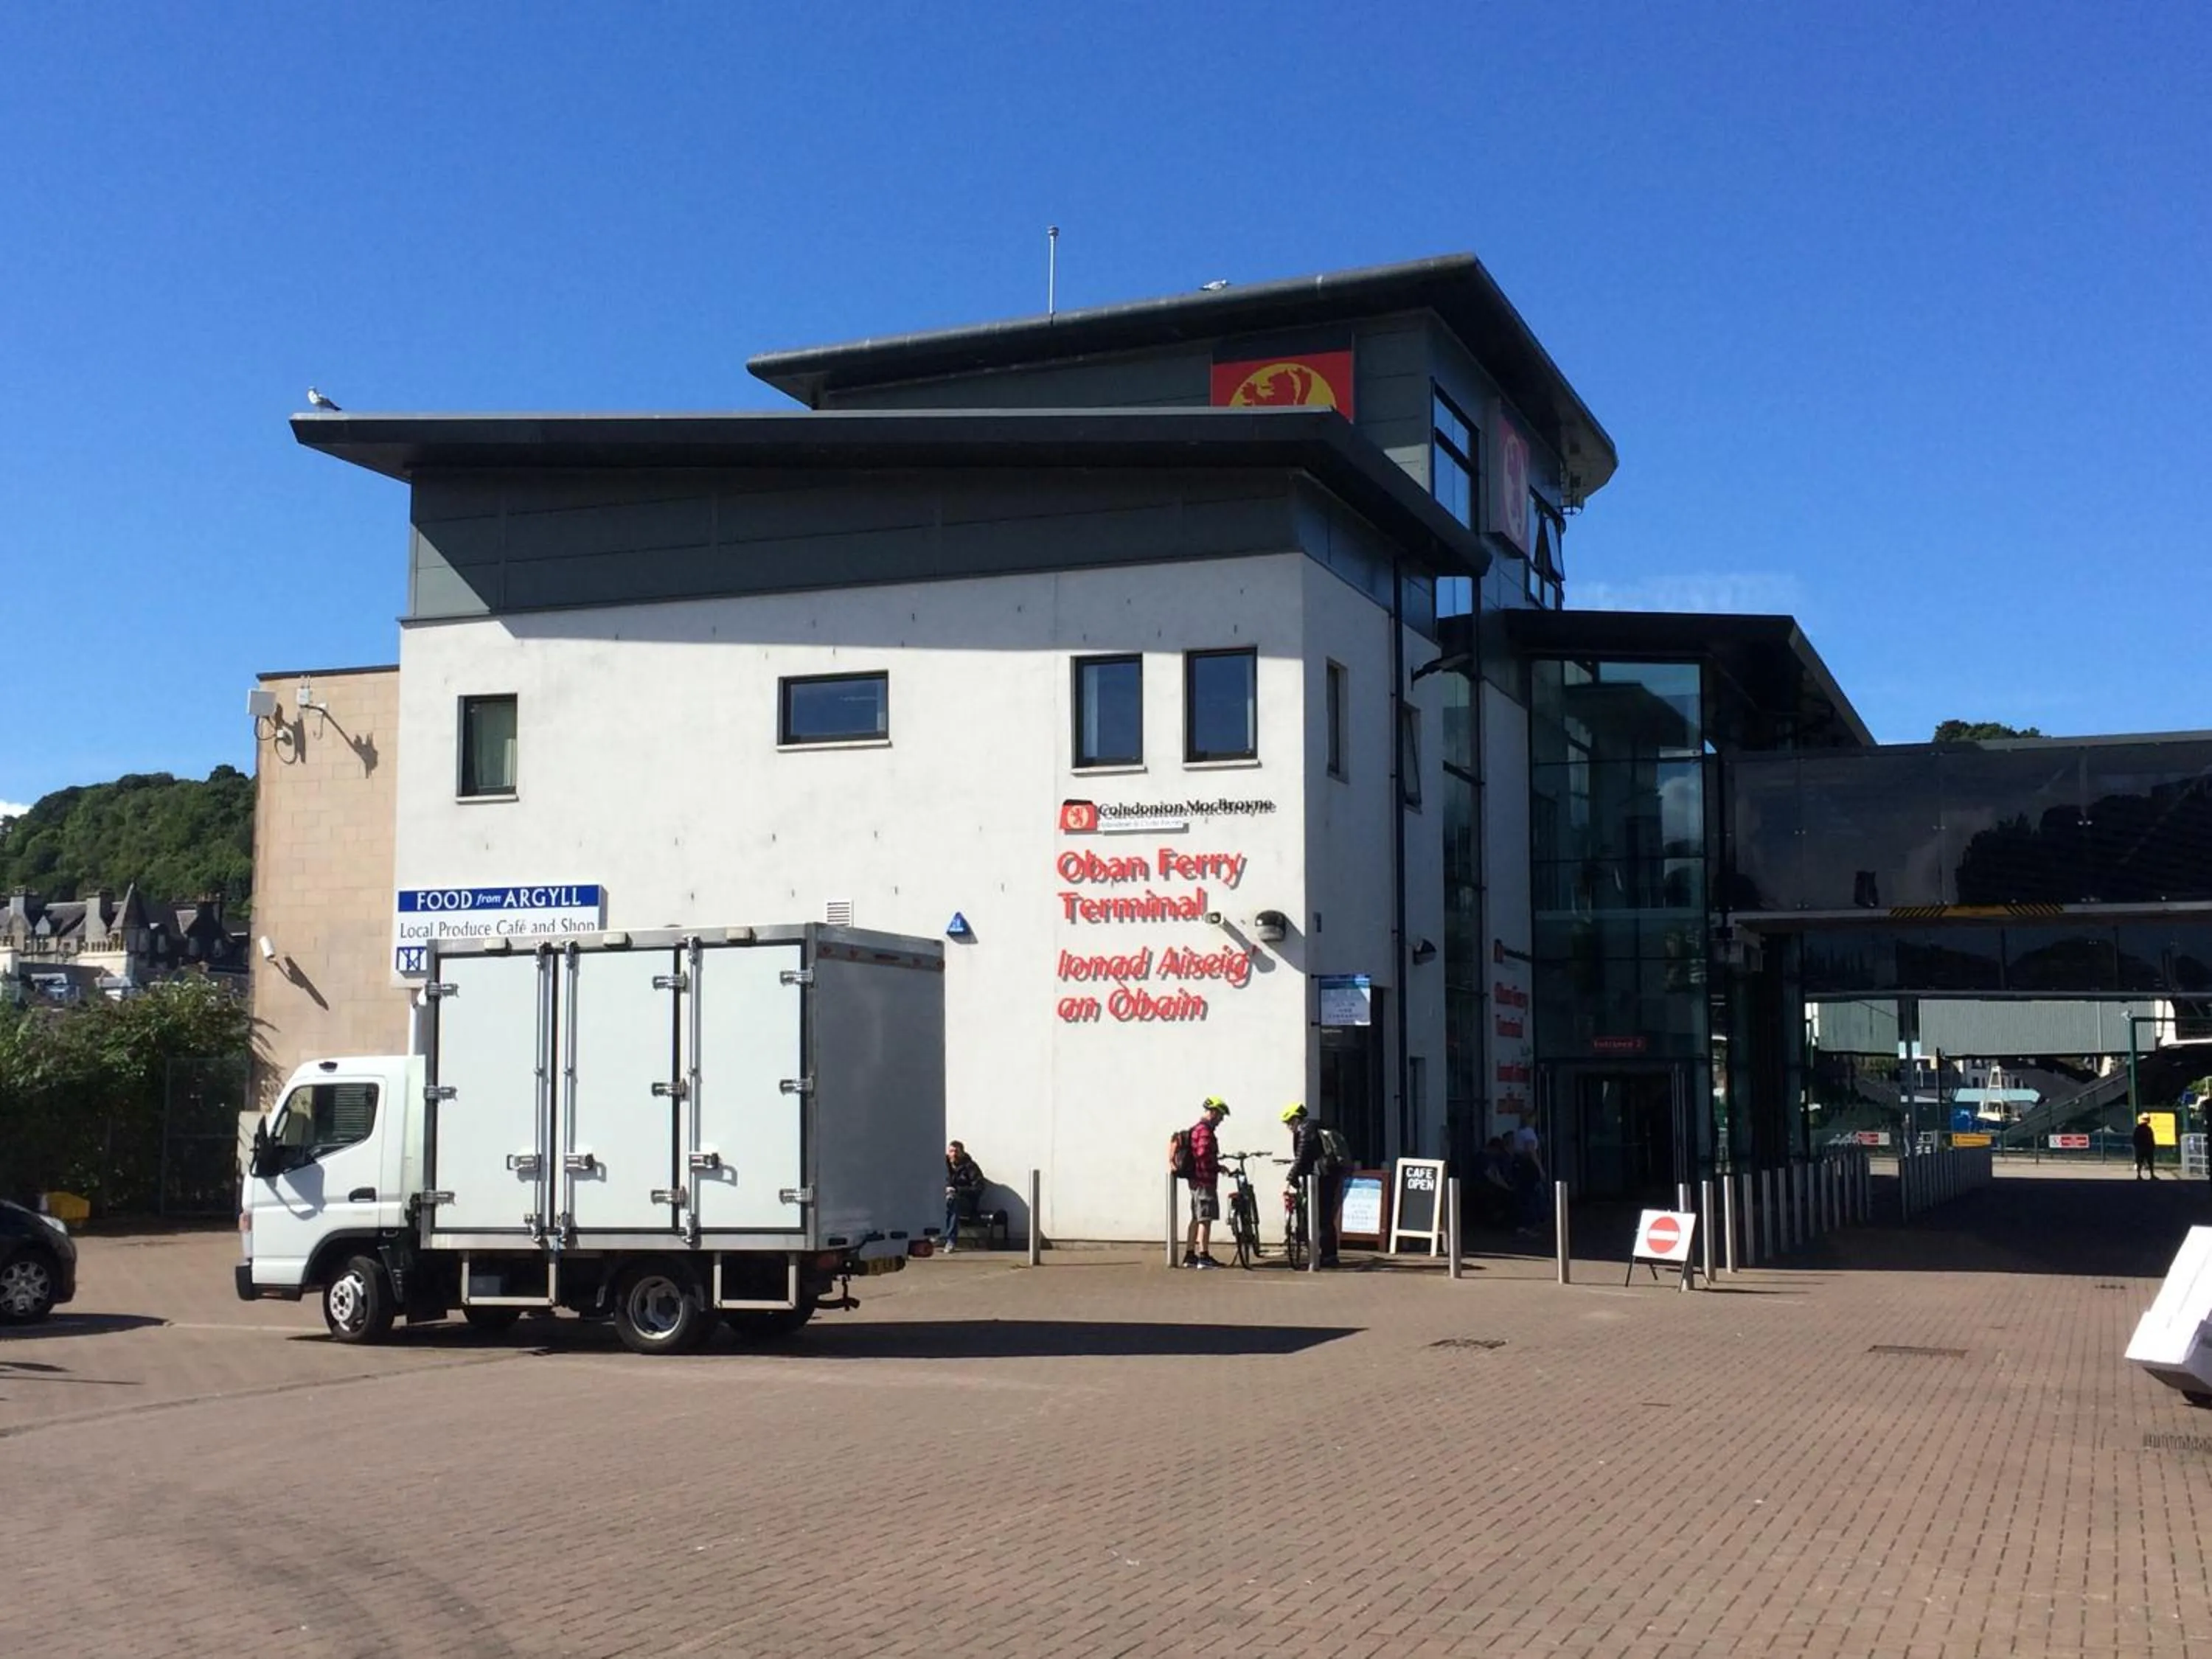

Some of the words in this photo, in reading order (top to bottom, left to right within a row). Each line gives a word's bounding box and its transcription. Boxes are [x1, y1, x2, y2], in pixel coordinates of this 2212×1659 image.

[1057, 849, 1146, 880] Oban
[1158, 848, 1242, 883] Ferry
[416, 891, 472, 910] FOOD
[476, 893, 501, 905] from
[503, 887, 582, 908] ARGYLL
[1058, 887, 1204, 920] Terminal
[400, 922, 433, 939] Local
[438, 920, 490, 936] Produce
[495, 919, 526, 935] Café
[530, 919, 555, 933] and
[1057, 946, 1147, 978] Ionad
[1156, 945, 1251, 984] Aiseig
[1057, 998, 1098, 1019] an
[1108, 988, 1203, 1020] Obain
[1406, 1167, 1433, 1179] CAFE
[1408, 1178, 1434, 1191] OPEN
